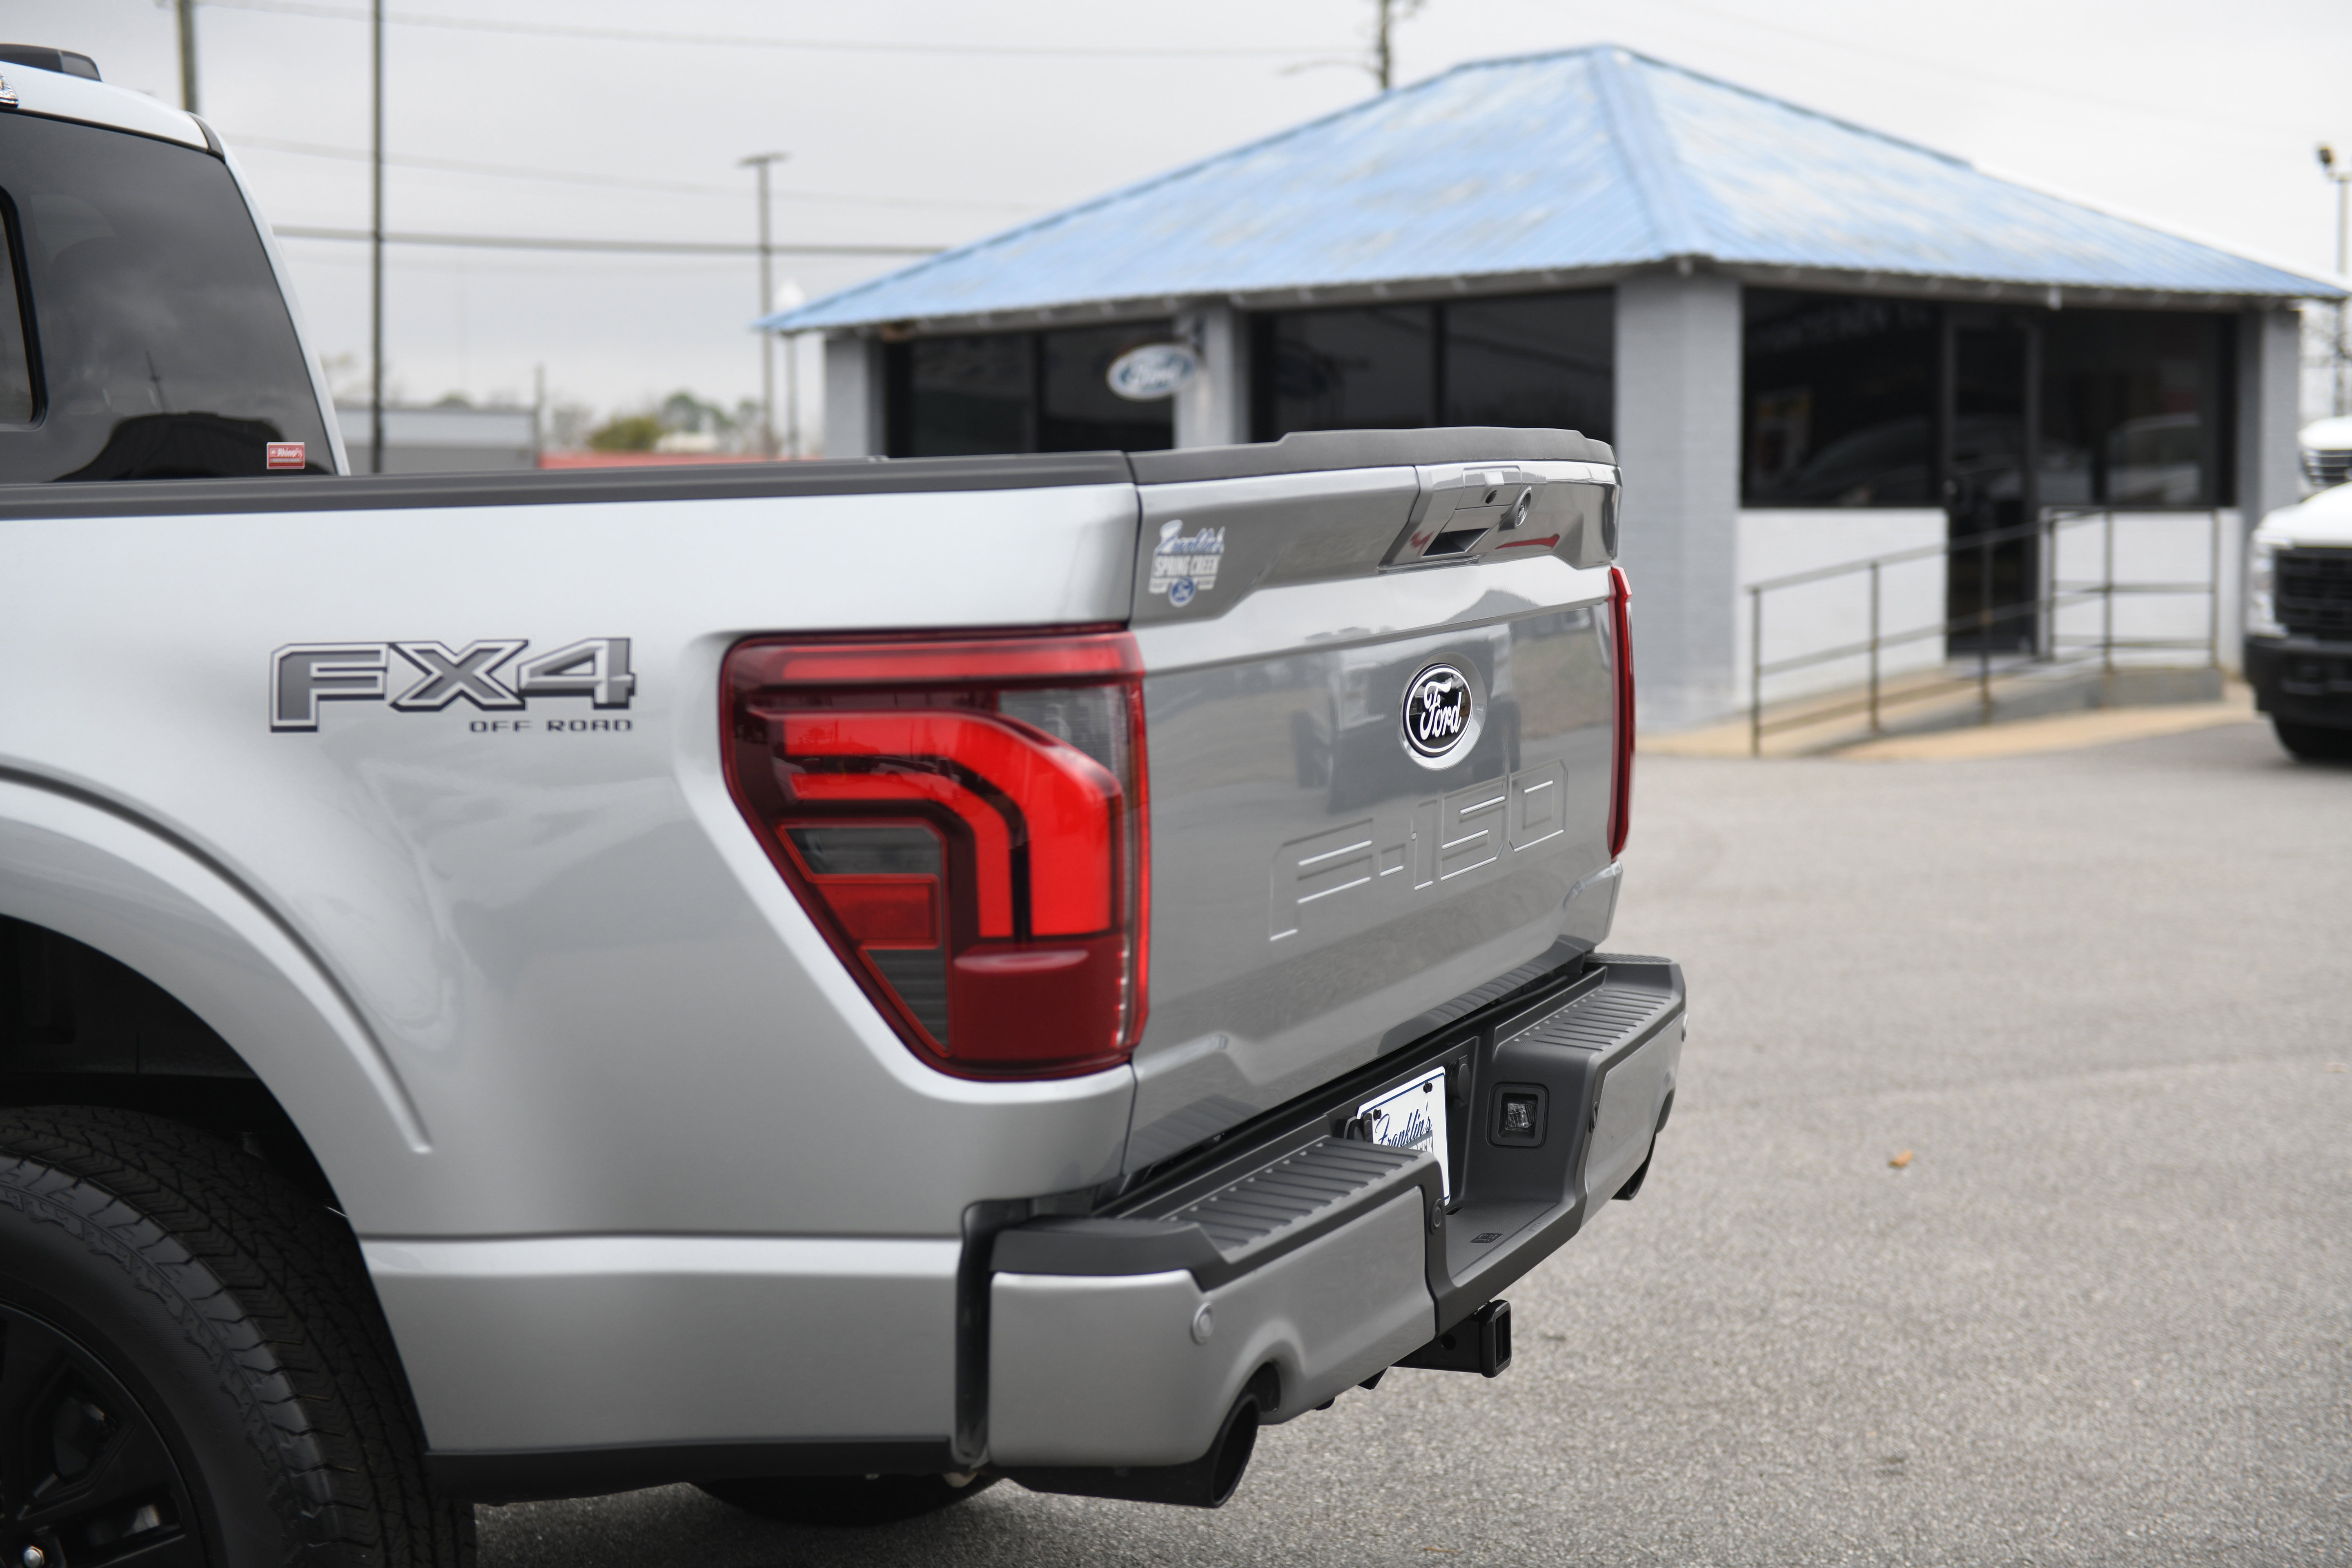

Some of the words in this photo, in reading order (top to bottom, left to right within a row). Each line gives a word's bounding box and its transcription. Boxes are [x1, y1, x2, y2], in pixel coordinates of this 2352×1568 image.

[270, 637, 635, 733] FX4
[1420, 681, 1462, 740] Ford
[469, 719, 532, 733] OFF
[546, 718, 633, 732] ROAD
[1374, 1101, 1432, 1148] Franklin's
